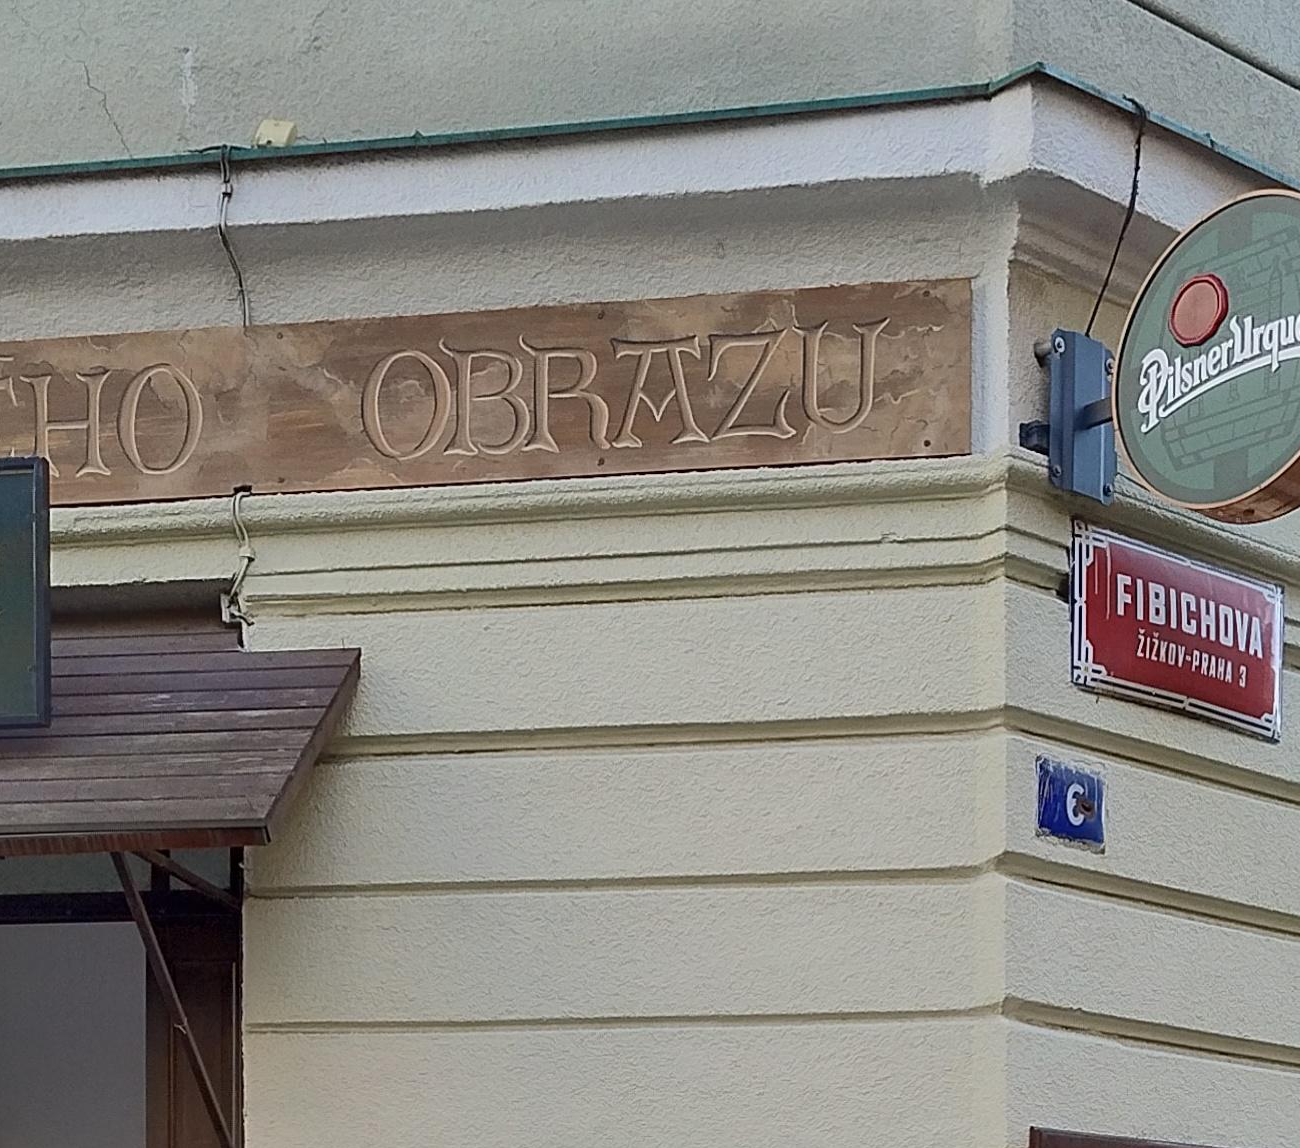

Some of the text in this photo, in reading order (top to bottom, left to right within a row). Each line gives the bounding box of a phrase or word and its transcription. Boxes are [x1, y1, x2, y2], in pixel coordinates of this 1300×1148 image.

[361, 316, 893, 461] OBRAZU
[1138, 337, 1238, 433] Pilsner
[1115, 572, 1264, 660] FIBICHOVA
[1136, 627, 1248, 689] ŽIŽKOV-PRAHA 3
